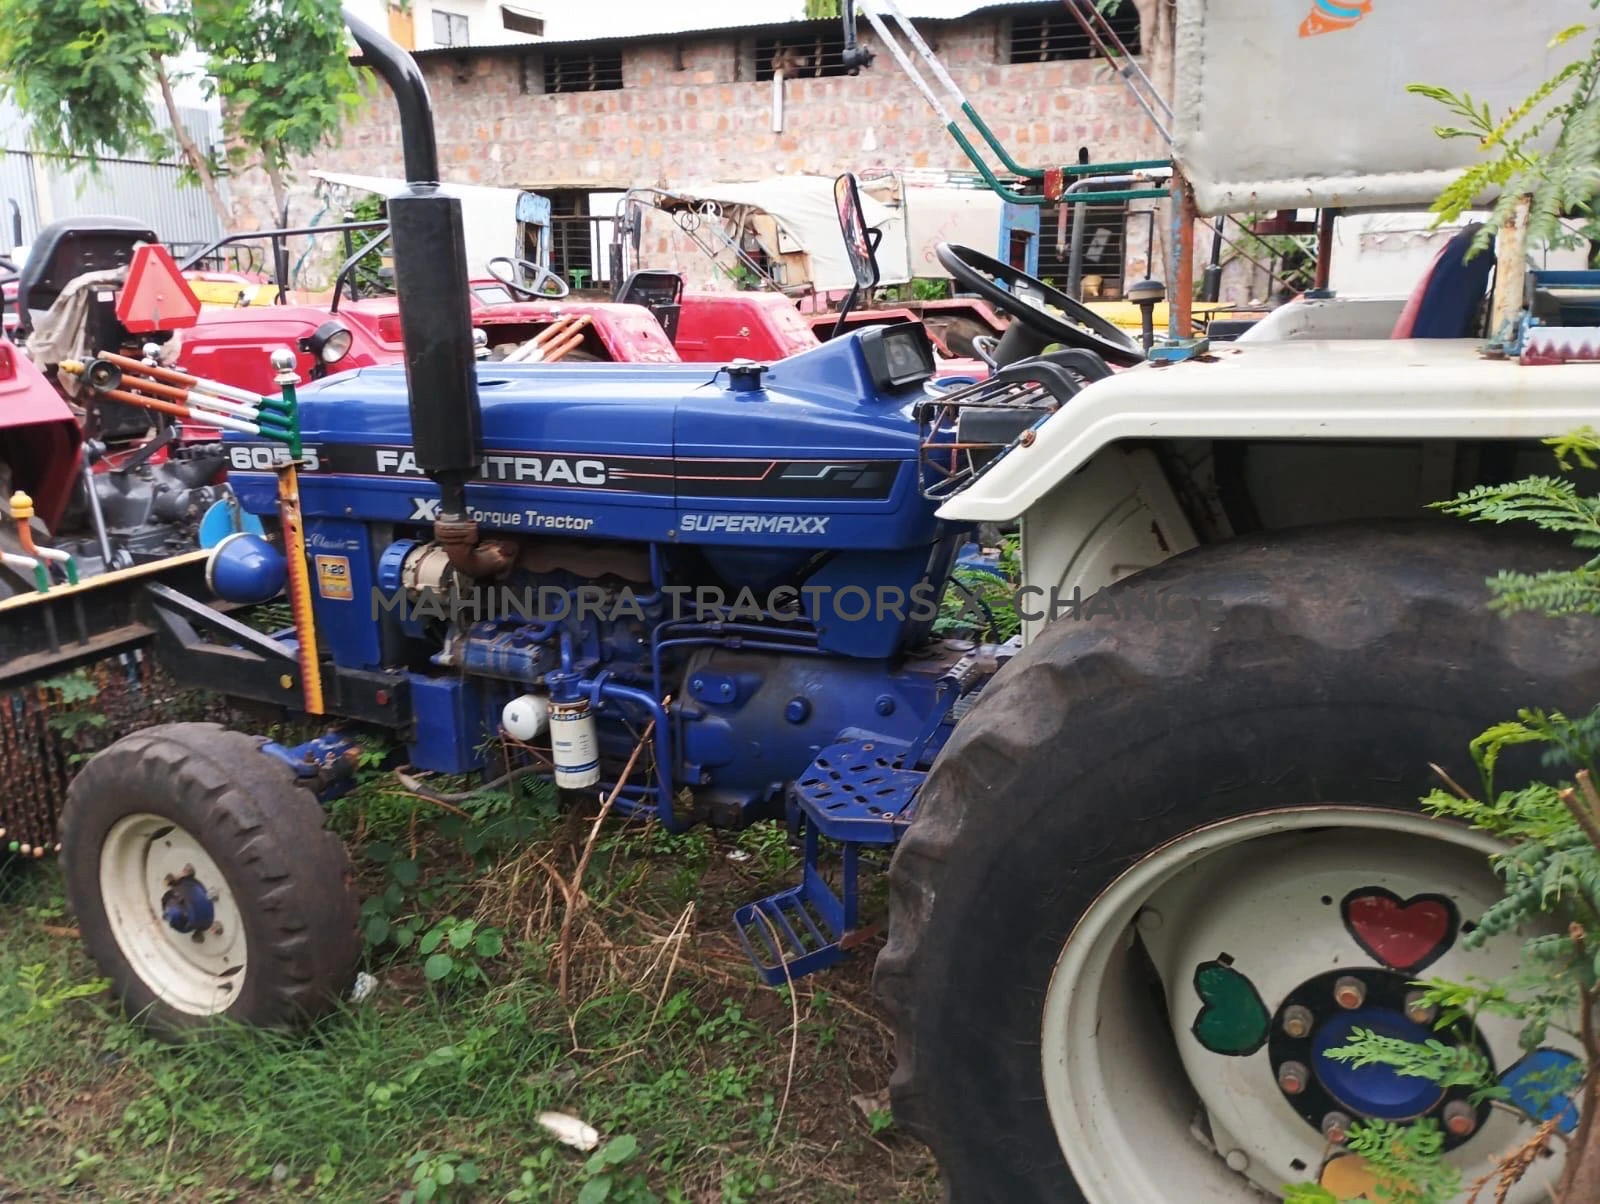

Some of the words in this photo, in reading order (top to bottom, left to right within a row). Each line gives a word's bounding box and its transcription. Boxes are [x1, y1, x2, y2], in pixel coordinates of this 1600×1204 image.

[376, 450, 605, 485] FATRAC
[525, 511, 593, 530] Tractor
[680, 515, 829, 535] SUPERMAXX
